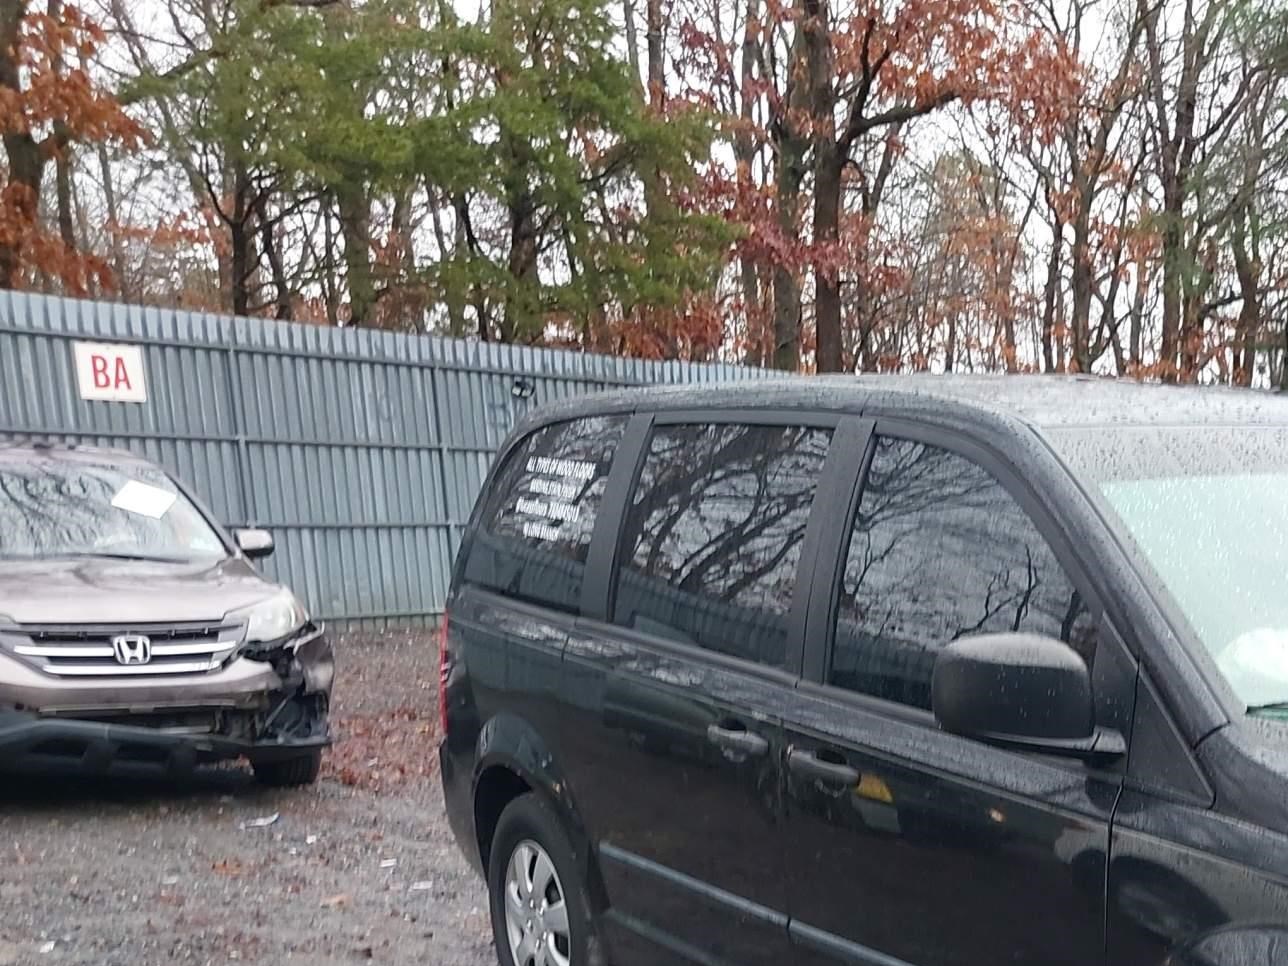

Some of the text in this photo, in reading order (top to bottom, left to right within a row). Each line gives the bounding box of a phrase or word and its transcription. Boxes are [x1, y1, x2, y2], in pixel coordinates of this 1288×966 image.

[91, 354, 132, 390] BA
[526, 456, 597, 480] ALL TYPES OF WOOD FLOORS
